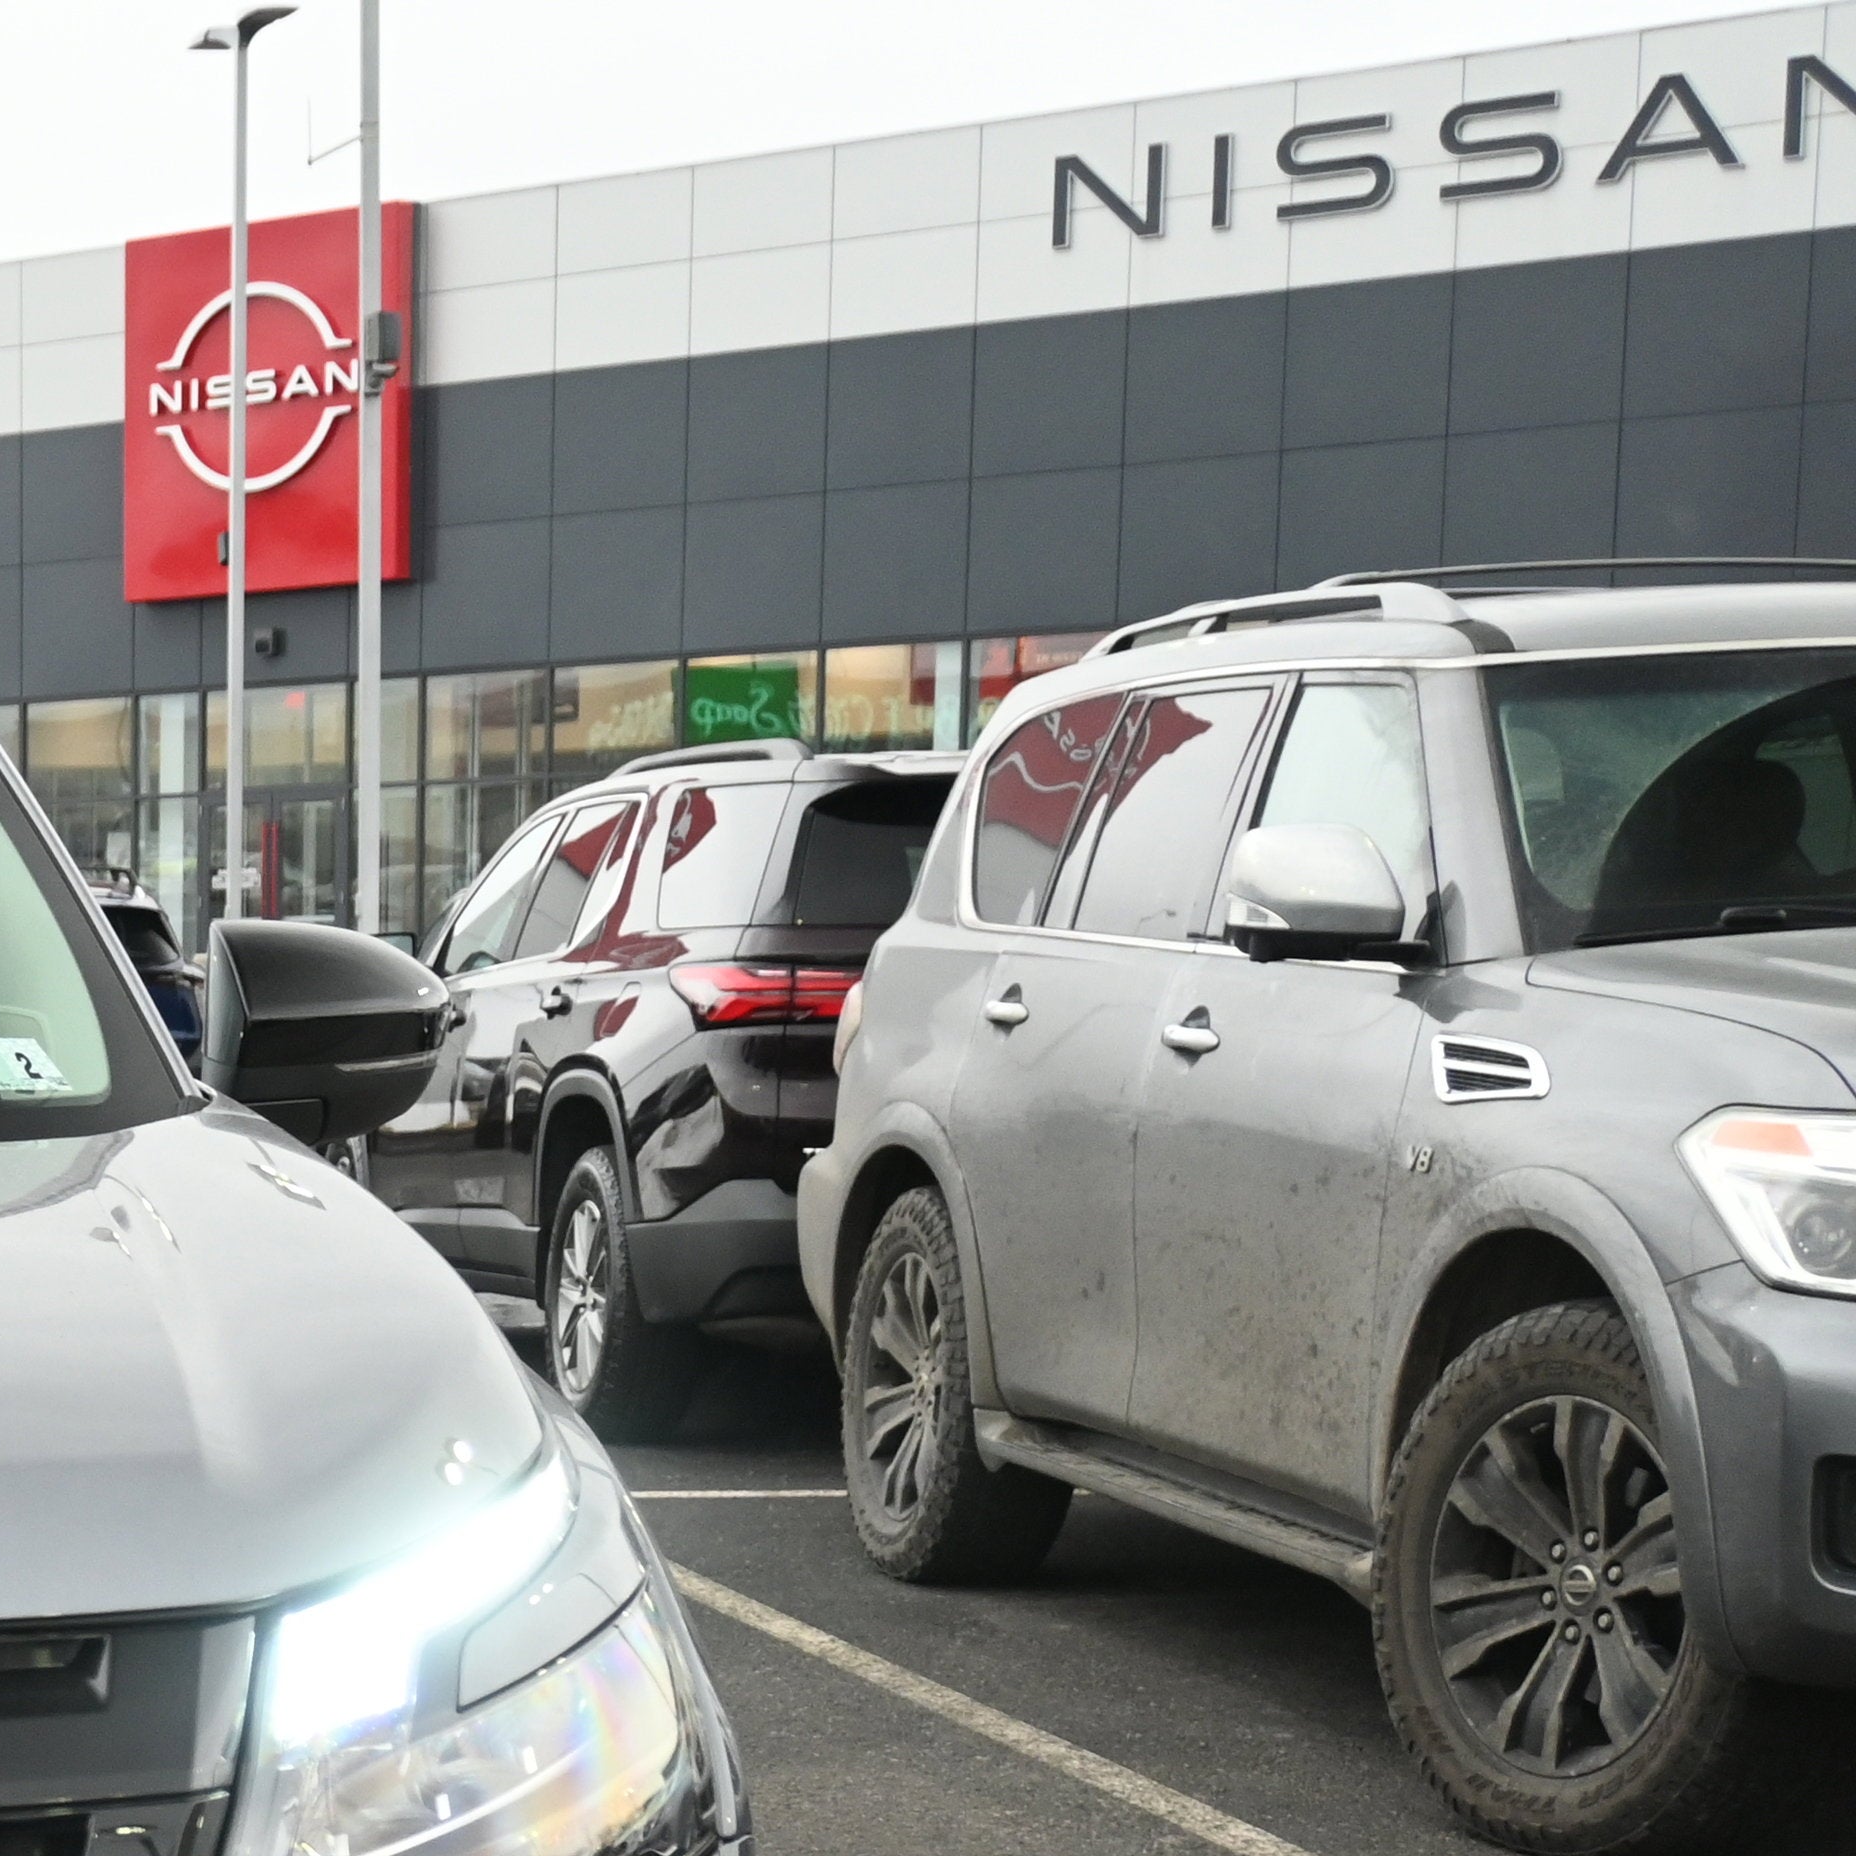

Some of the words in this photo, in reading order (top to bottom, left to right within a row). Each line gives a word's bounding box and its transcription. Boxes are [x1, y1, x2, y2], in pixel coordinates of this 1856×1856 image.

[149, 358, 359, 416] NISSAN
[15, 1052, 43, 1079] 2
[1407, 1144, 1434, 1173] V8
